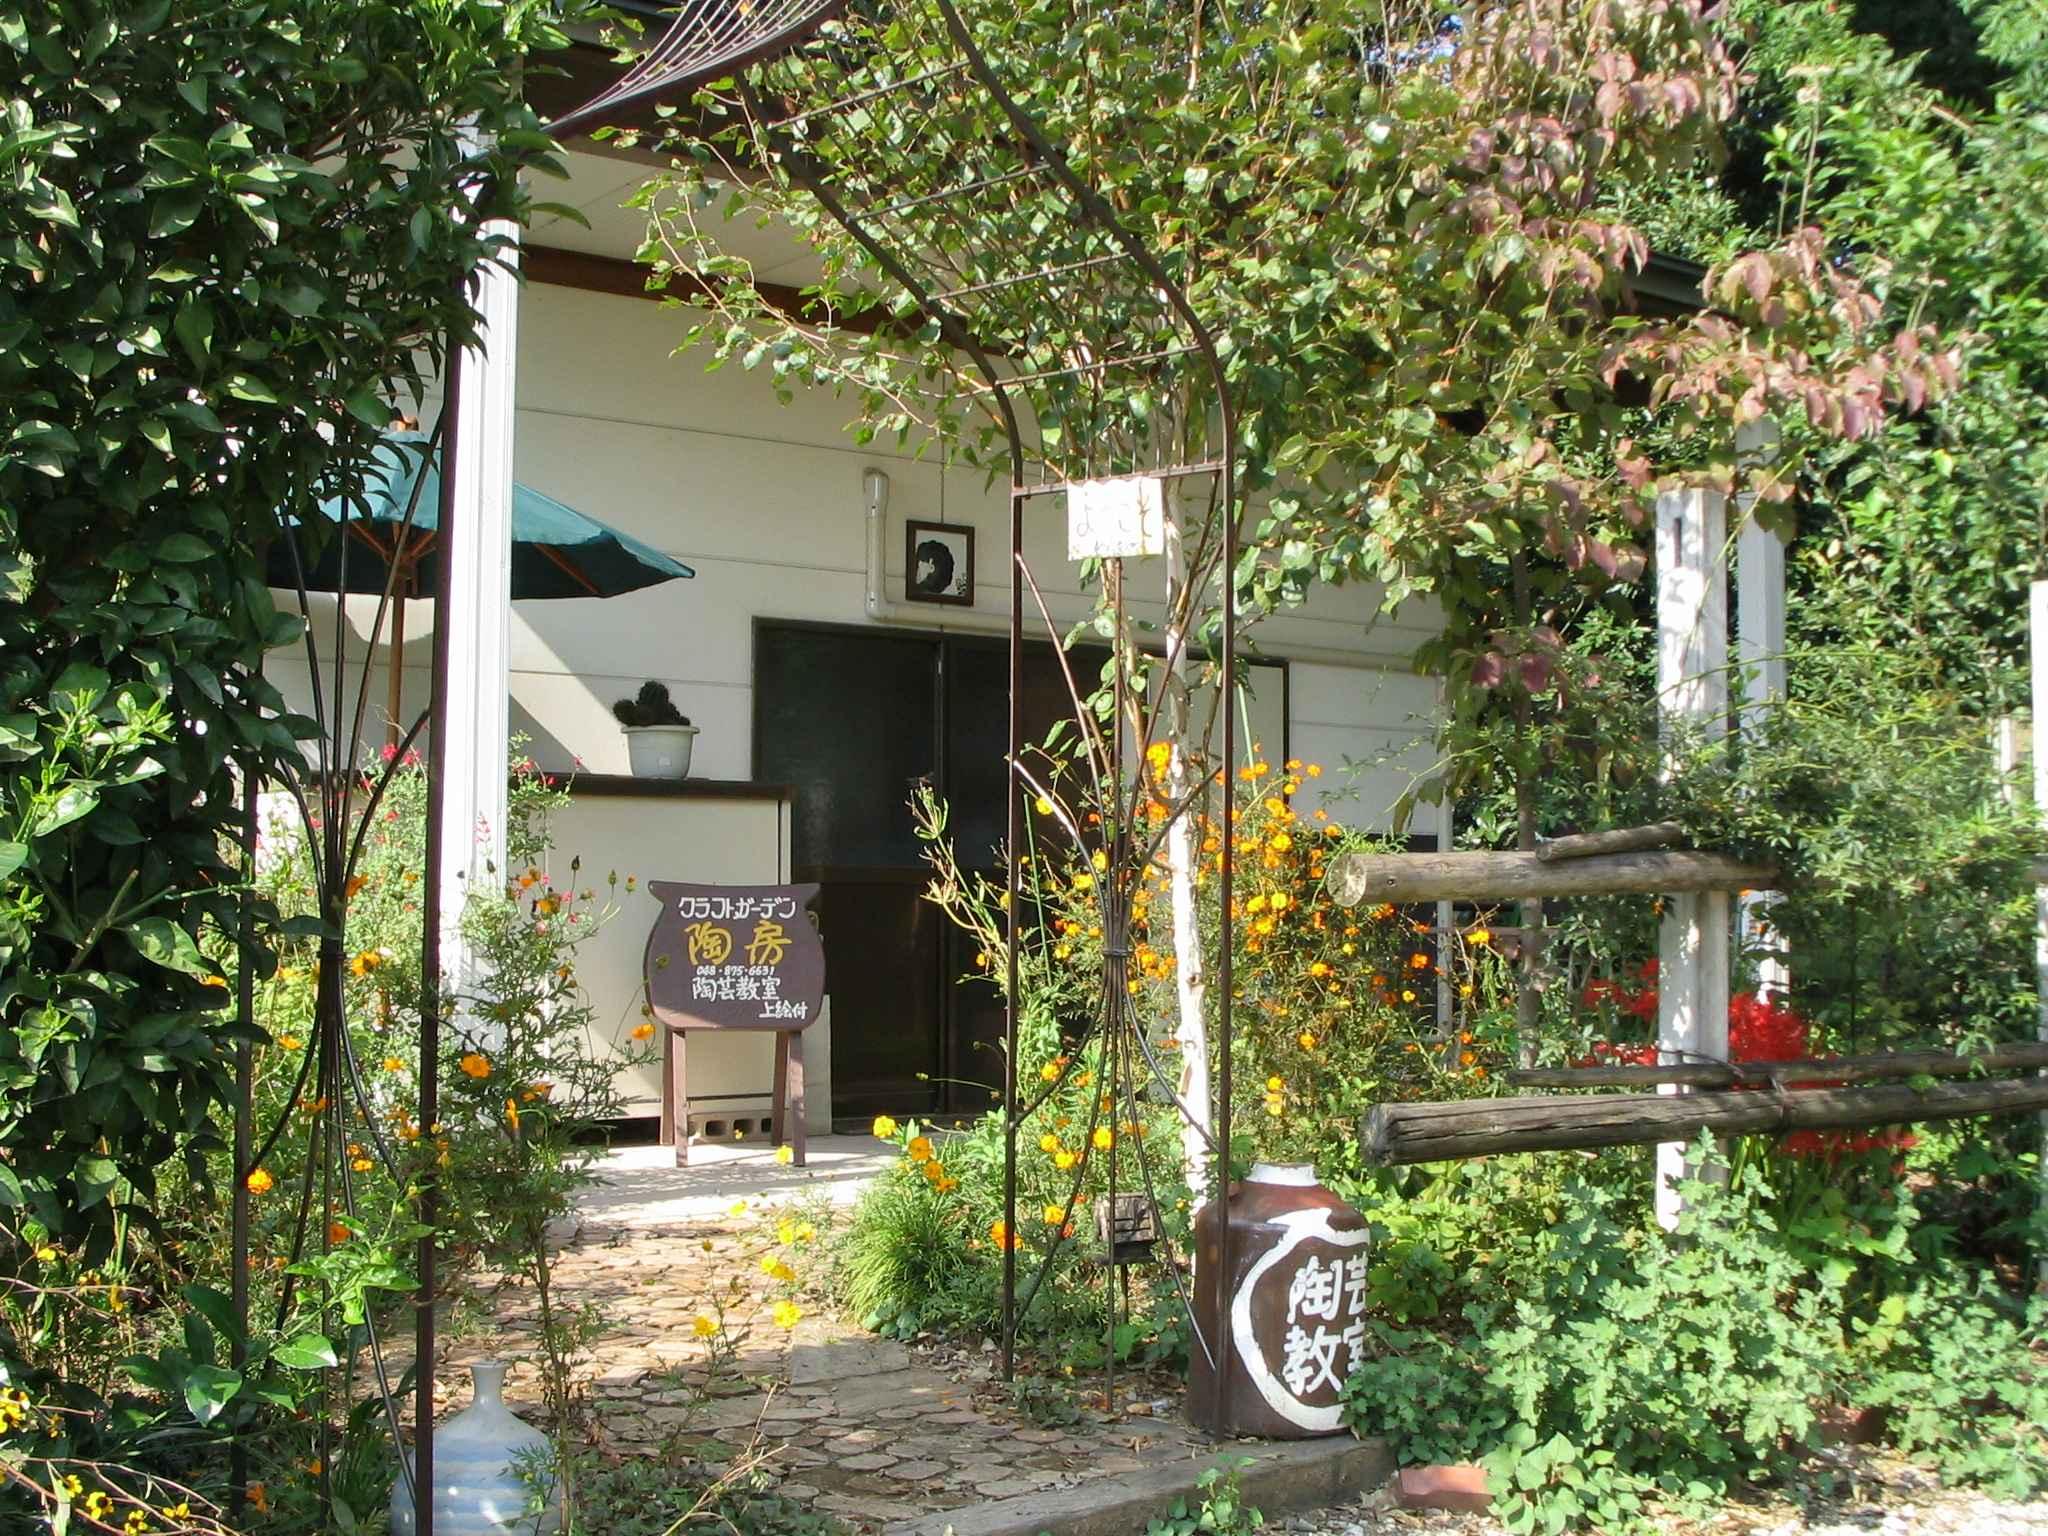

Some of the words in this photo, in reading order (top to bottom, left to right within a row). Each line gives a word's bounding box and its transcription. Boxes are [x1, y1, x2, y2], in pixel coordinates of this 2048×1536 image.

[679, 897, 796, 920] クラフトガーデン
[692, 976, 781, 1002] 陶芸教室
[758, 1000, 809, 1020] 上絵付
